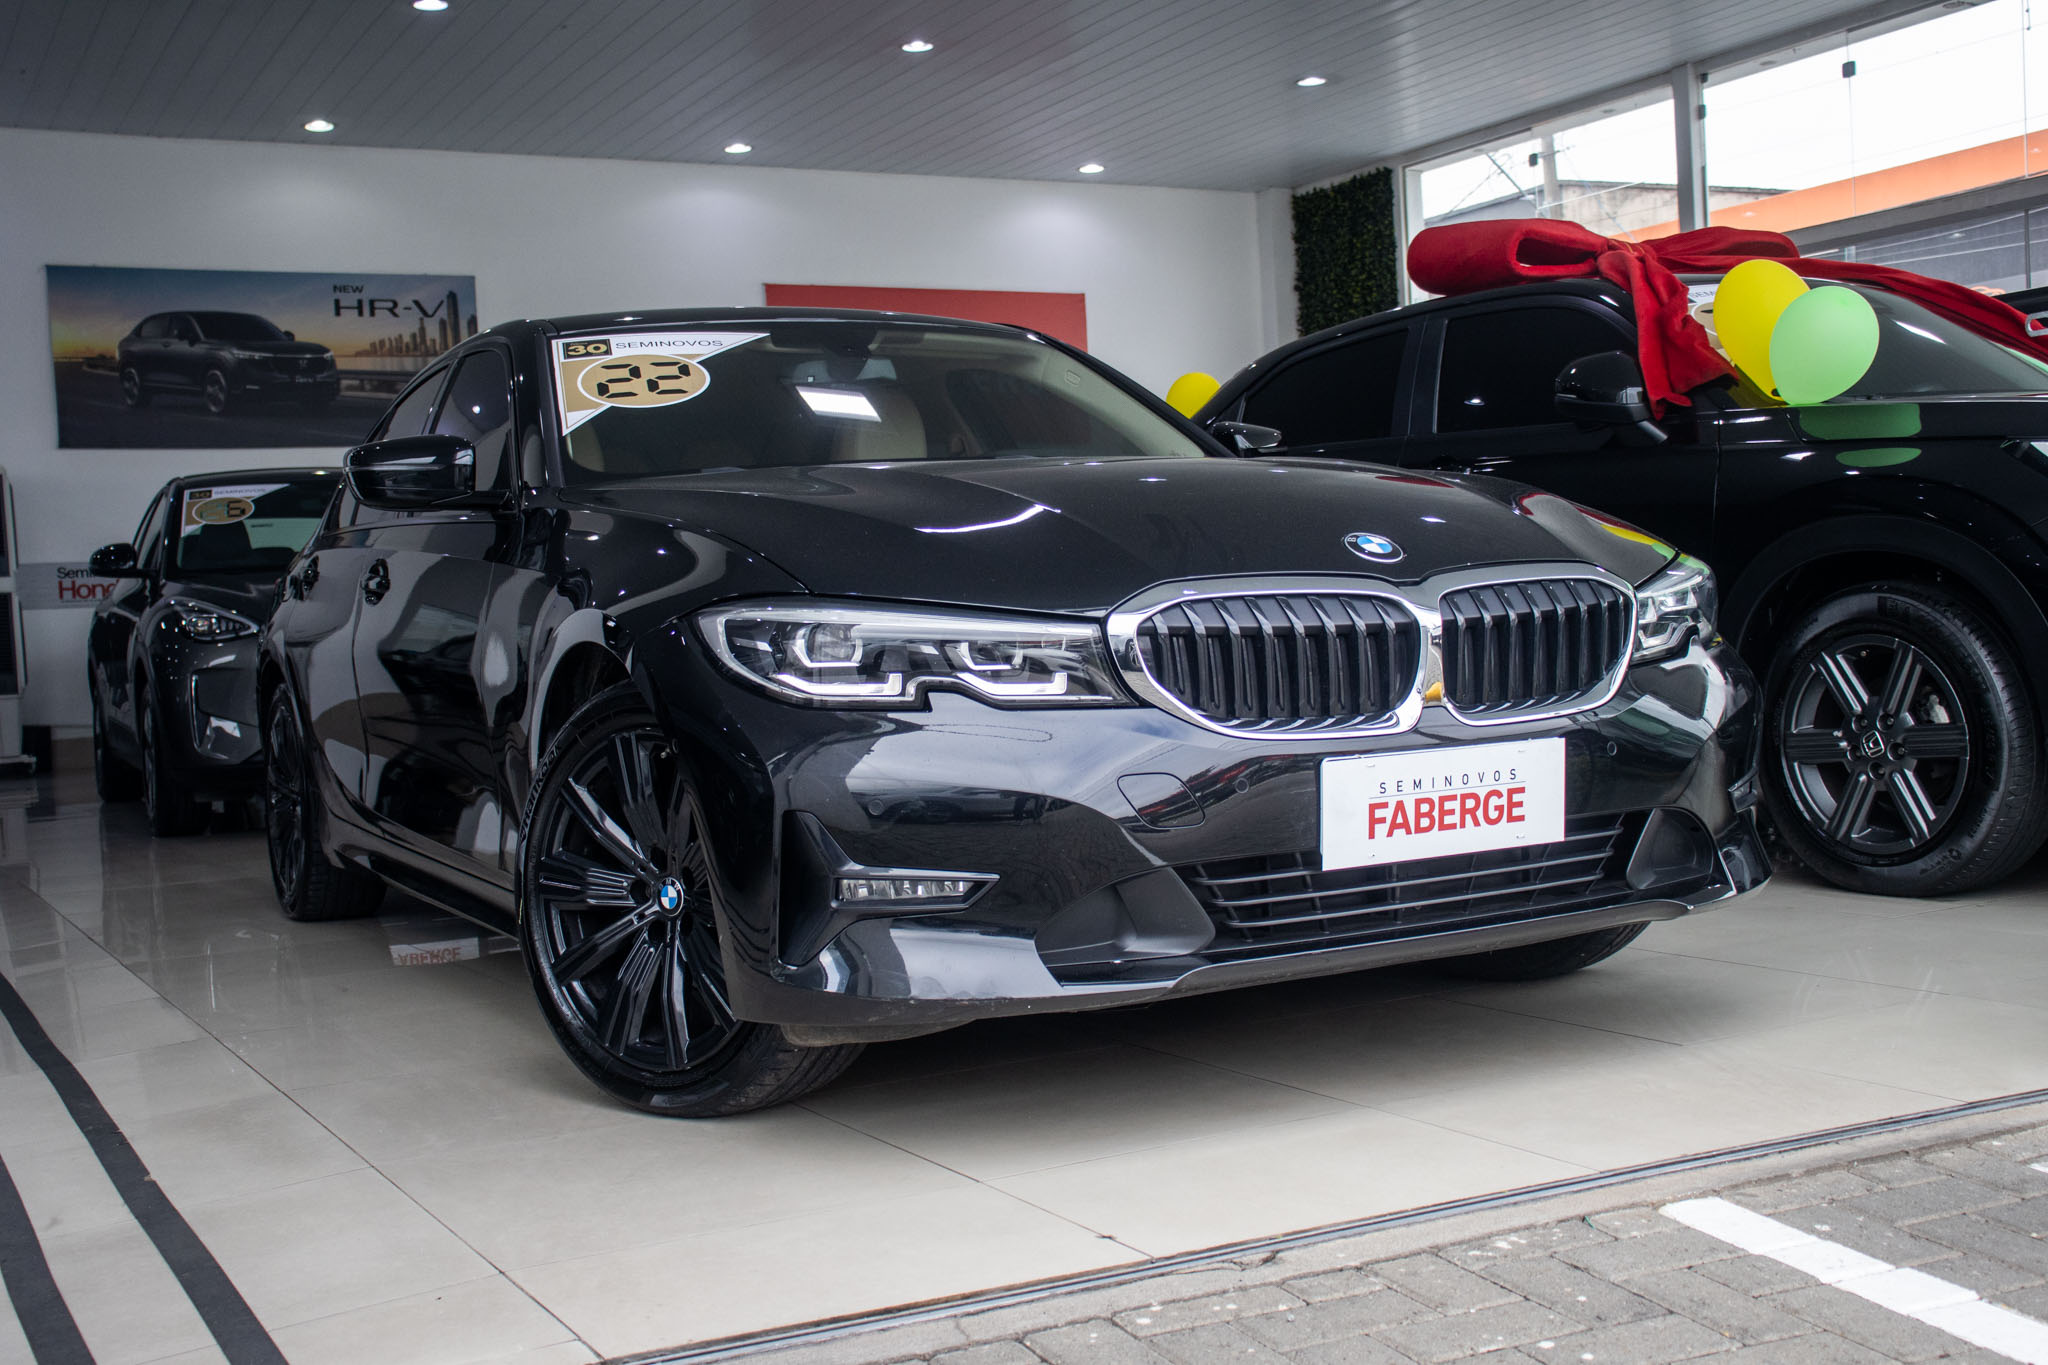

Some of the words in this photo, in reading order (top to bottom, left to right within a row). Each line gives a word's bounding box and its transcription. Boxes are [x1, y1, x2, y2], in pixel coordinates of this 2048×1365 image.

[333, 284, 364, 294] NEW
[333, 298, 445, 318] HR-V
[567, 342, 608, 356] 30
[615, 339, 724, 350] SEMINOVOS
[596, 361, 691, 399] 22
[1379, 768, 1517, 794] SEMINOVOS
[1368, 786, 1526, 840] FABERGE
